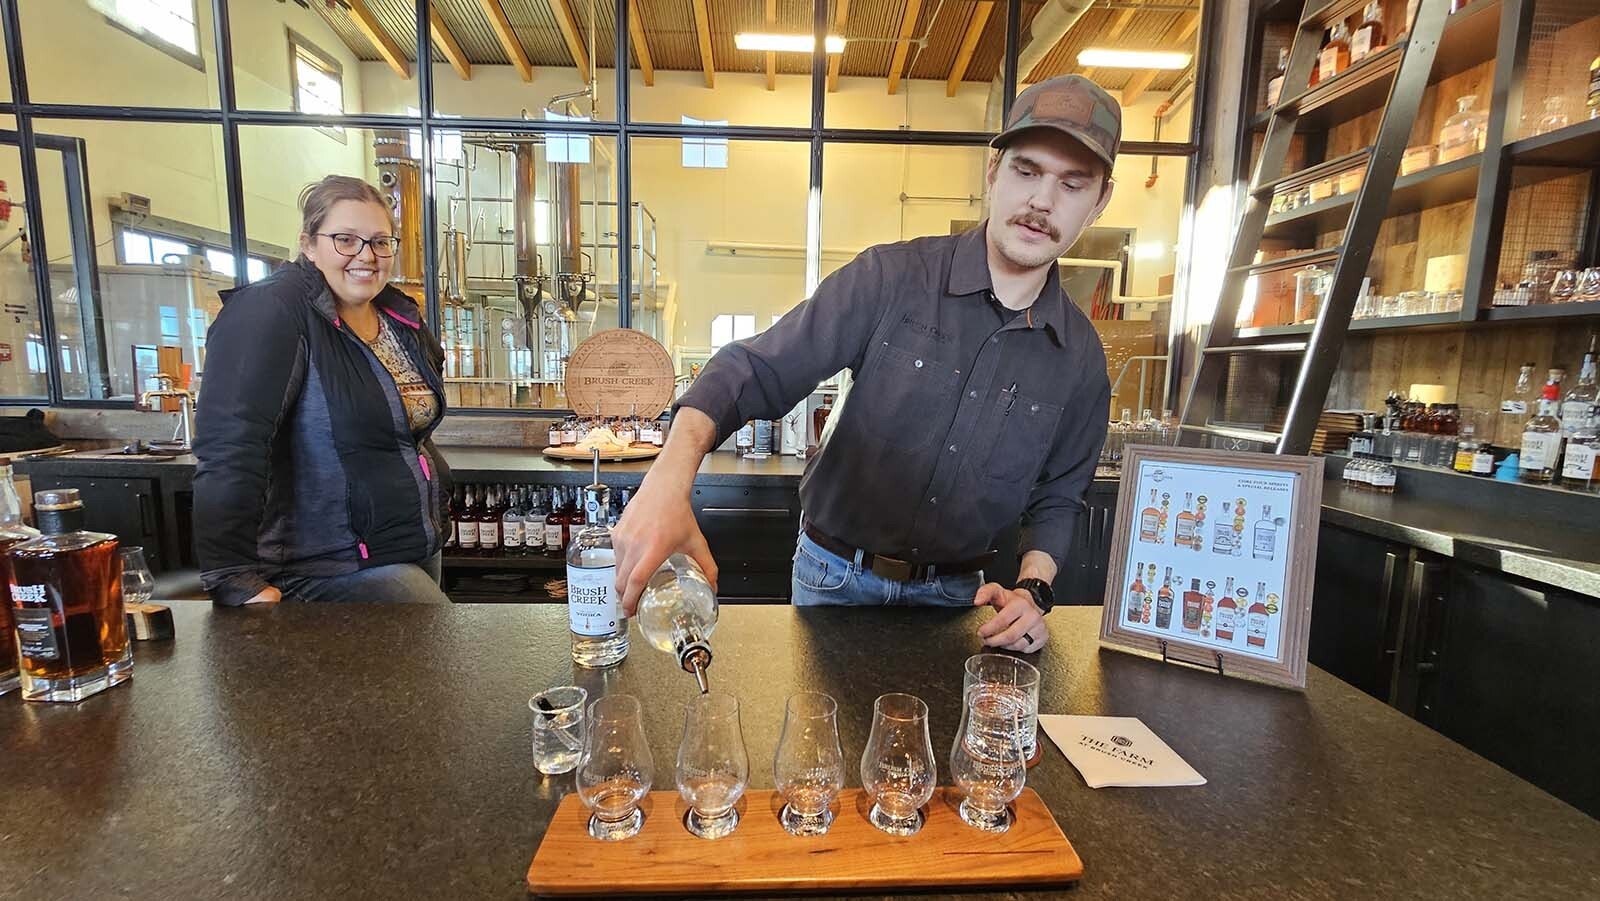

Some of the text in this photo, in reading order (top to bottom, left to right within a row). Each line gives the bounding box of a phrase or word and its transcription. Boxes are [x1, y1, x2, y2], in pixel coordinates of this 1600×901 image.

[584, 376, 655, 386] BRUSH CREEK
[570, 584, 607, 596] BRUSH
[570, 594, 607, 605] CREEK
[1081, 734, 1154, 766] THE FARM
